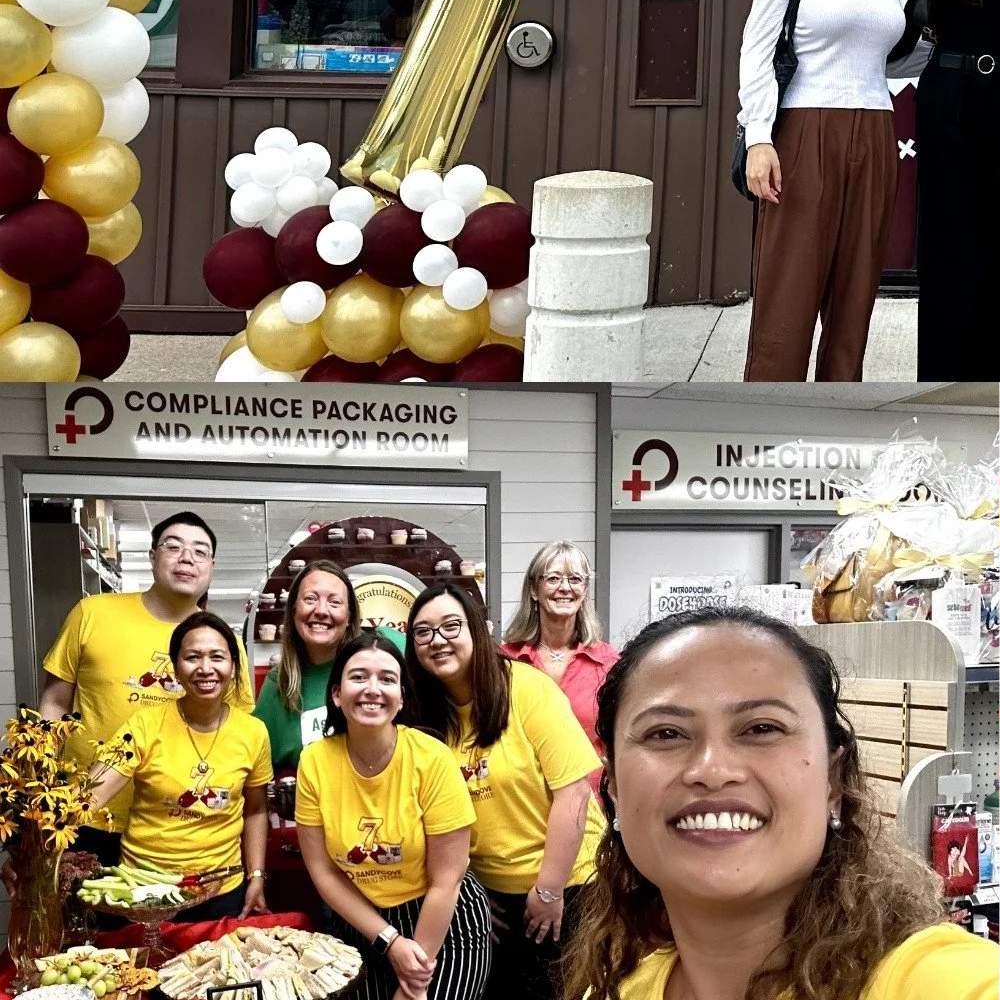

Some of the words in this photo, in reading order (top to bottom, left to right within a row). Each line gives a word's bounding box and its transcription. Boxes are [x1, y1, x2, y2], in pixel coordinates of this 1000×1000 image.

[124, 390, 302, 419] COMPLIANCE
[312, 399, 458, 425] PACKAGING
[135, 421, 192, 443] AND
[201, 424, 367, 450] AUTOMATION
[376, 431, 449, 453] ROOM
[716, 444, 861, 470] INJECTION
[686, 475, 846, 501] COUNSELIN
